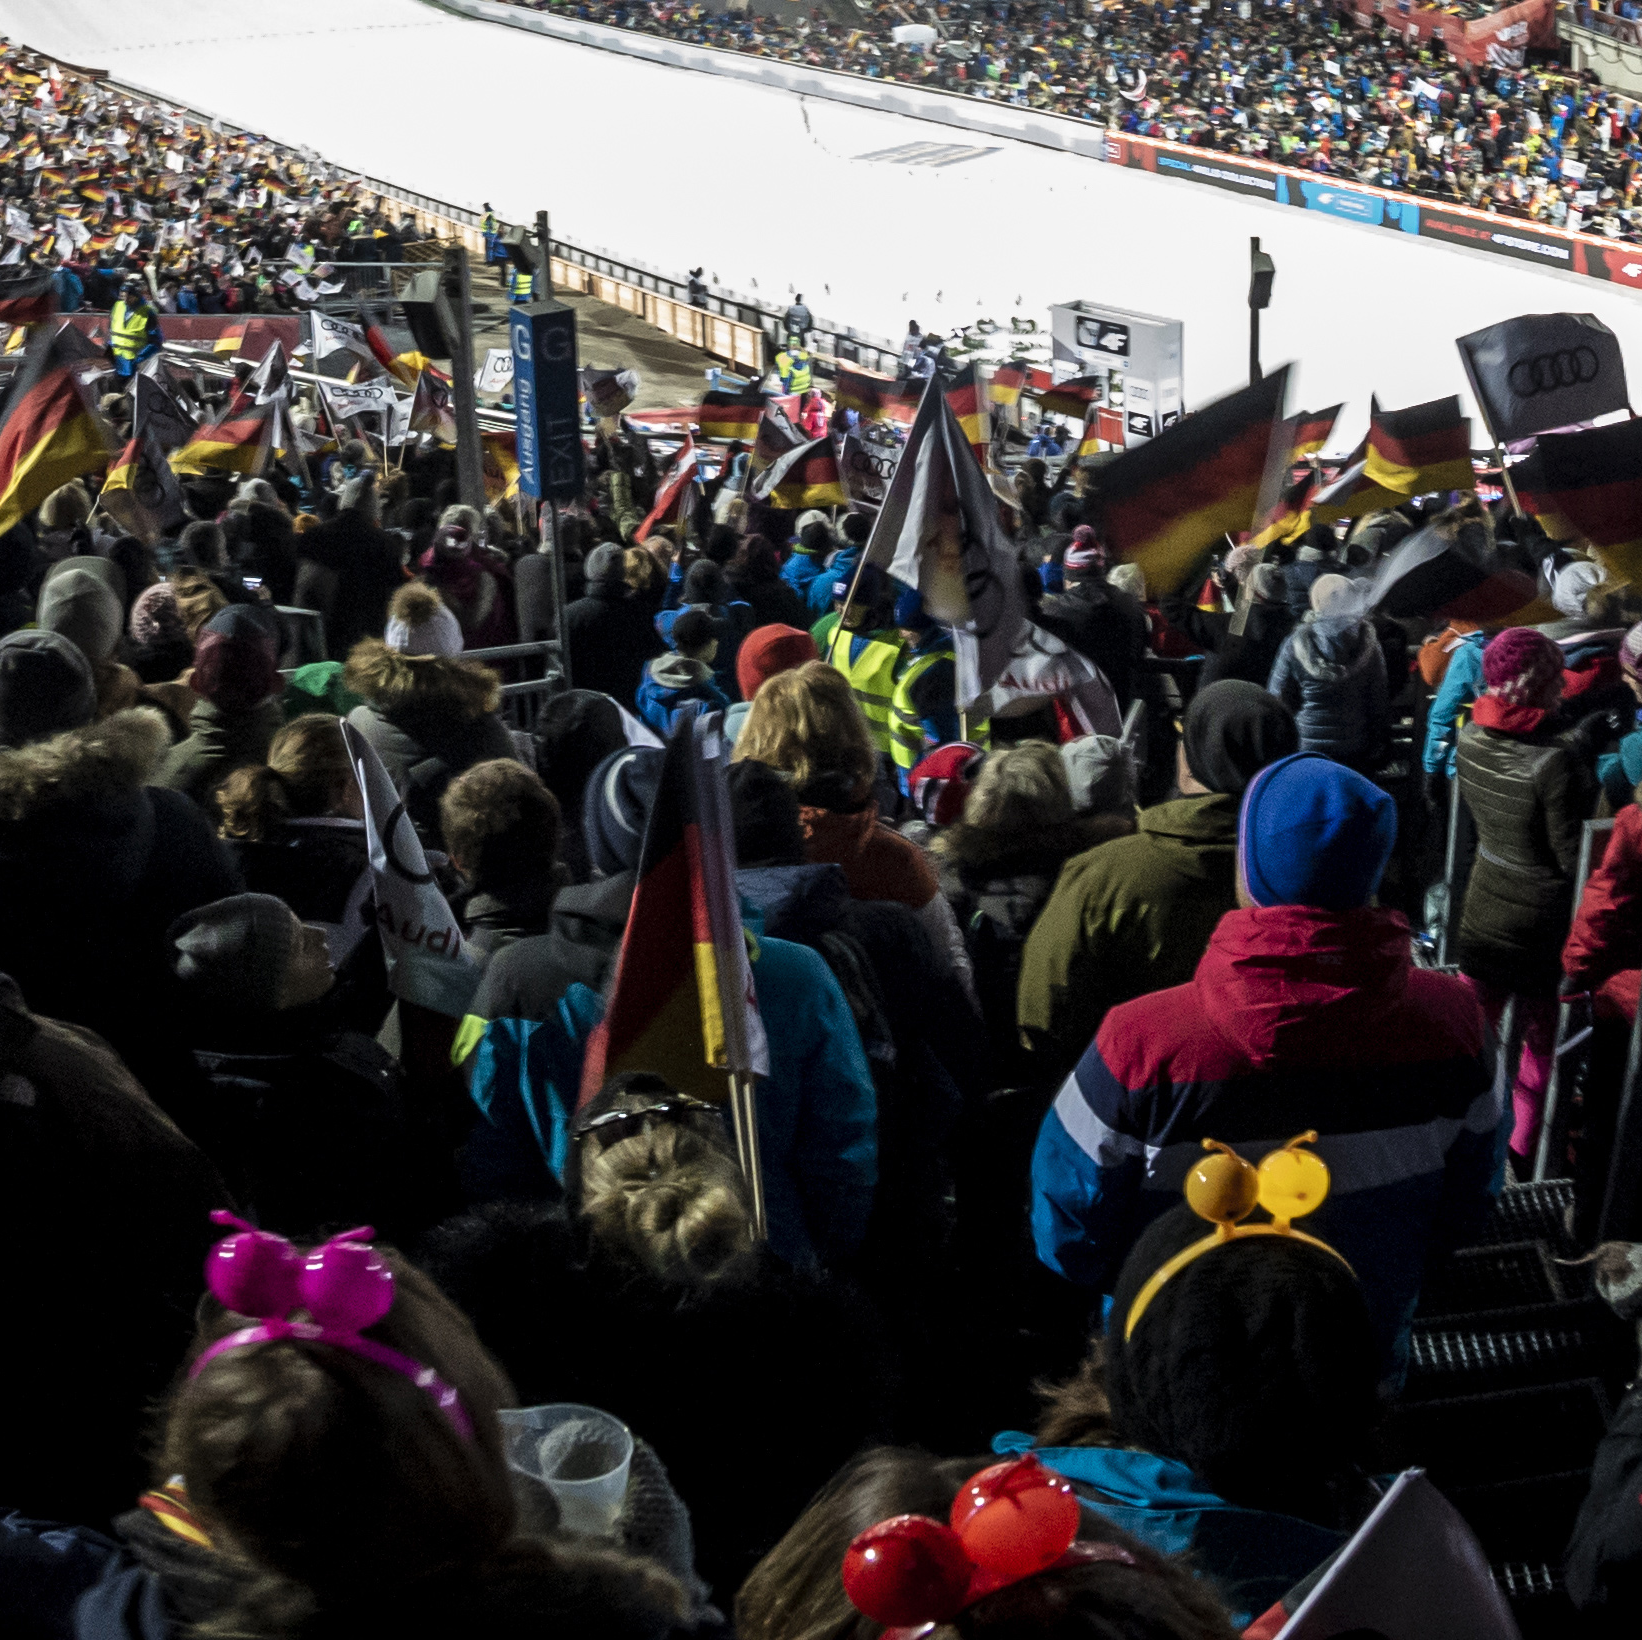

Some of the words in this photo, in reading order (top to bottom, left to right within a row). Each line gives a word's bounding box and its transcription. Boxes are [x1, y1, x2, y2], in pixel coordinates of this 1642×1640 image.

[513, 324, 532, 361] G
[518, 378, 535, 485] Ausgang
[546, 418, 576, 485] EXIT
[998, 671, 1070, 692] Audi
[376, 903, 460, 960] Audi
